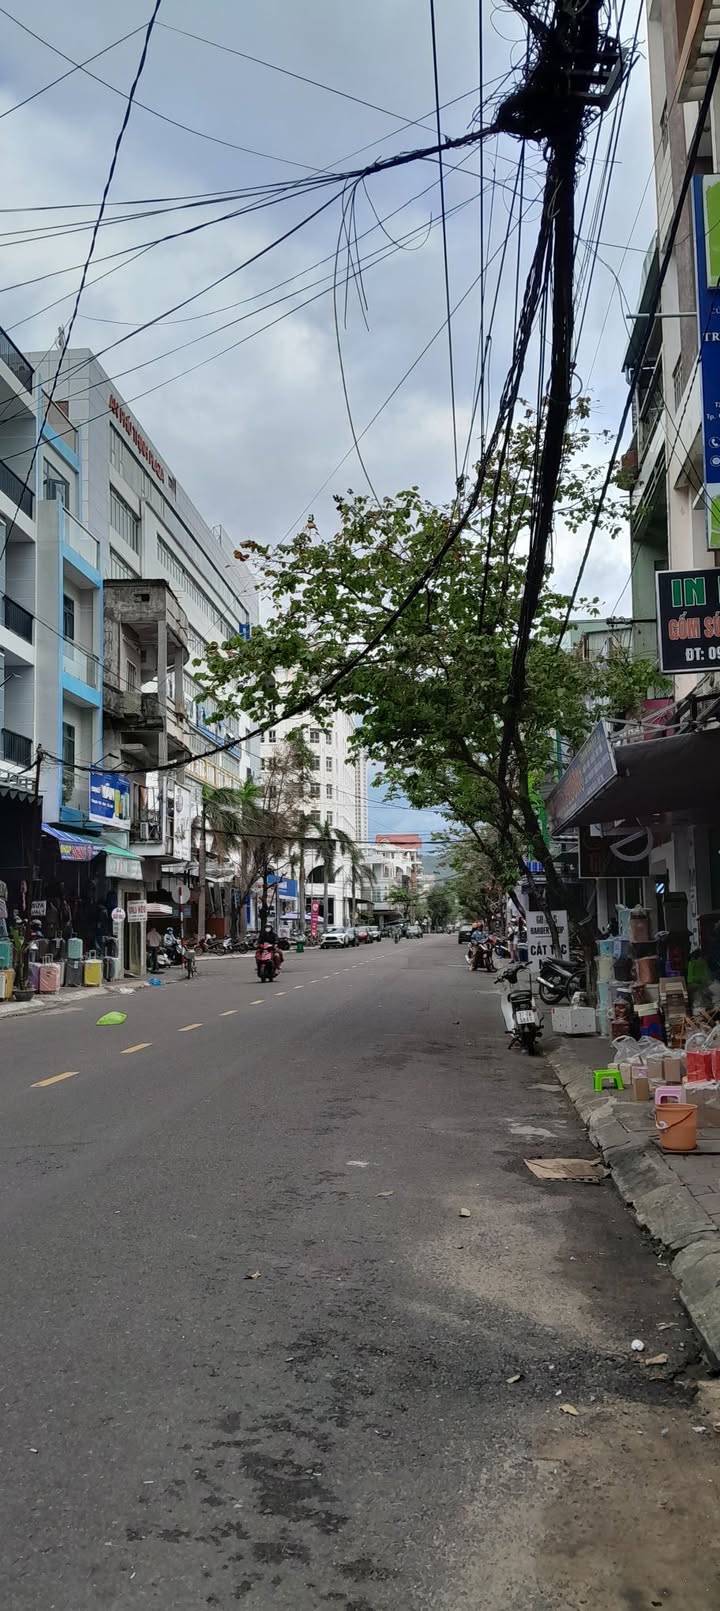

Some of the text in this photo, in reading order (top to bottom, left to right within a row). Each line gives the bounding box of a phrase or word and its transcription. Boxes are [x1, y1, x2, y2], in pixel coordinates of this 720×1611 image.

[671, 577, 706, 607] IN
[668, 611, 701, 640] GỐM
[685, 647, 704, 661] ĐT:
[549, 944, 567, 956] TC
